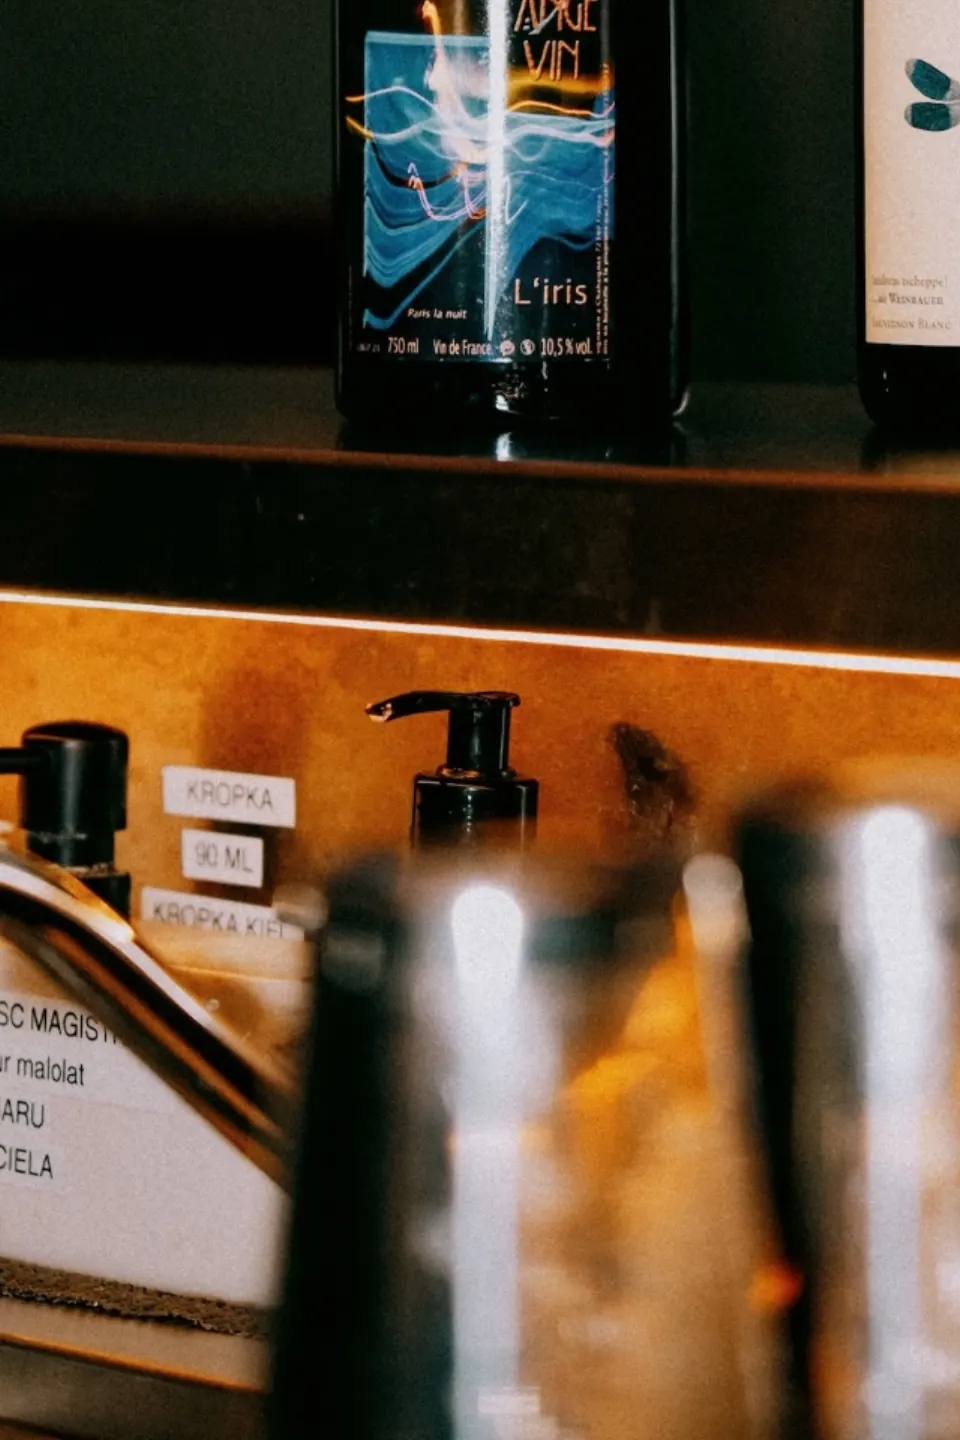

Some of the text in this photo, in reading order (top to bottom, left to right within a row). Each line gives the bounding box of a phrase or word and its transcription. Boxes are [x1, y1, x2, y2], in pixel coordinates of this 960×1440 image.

[523, 40, 580, 81] VIN
[407, 307, 468, 319] Paris la nuit
[388, 336, 406, 354] 750
[407, 337, 420, 353] ml
[433, 338, 492, 356] Vin de France
[185, 778, 274, 812] KROPKA
[194, 839, 254, 874] 90 ML
[152, 900, 238, 933] KROPKA
[17, 1056, 85, 1086] malolat
[1, 1098, 45, 1129] ARU
